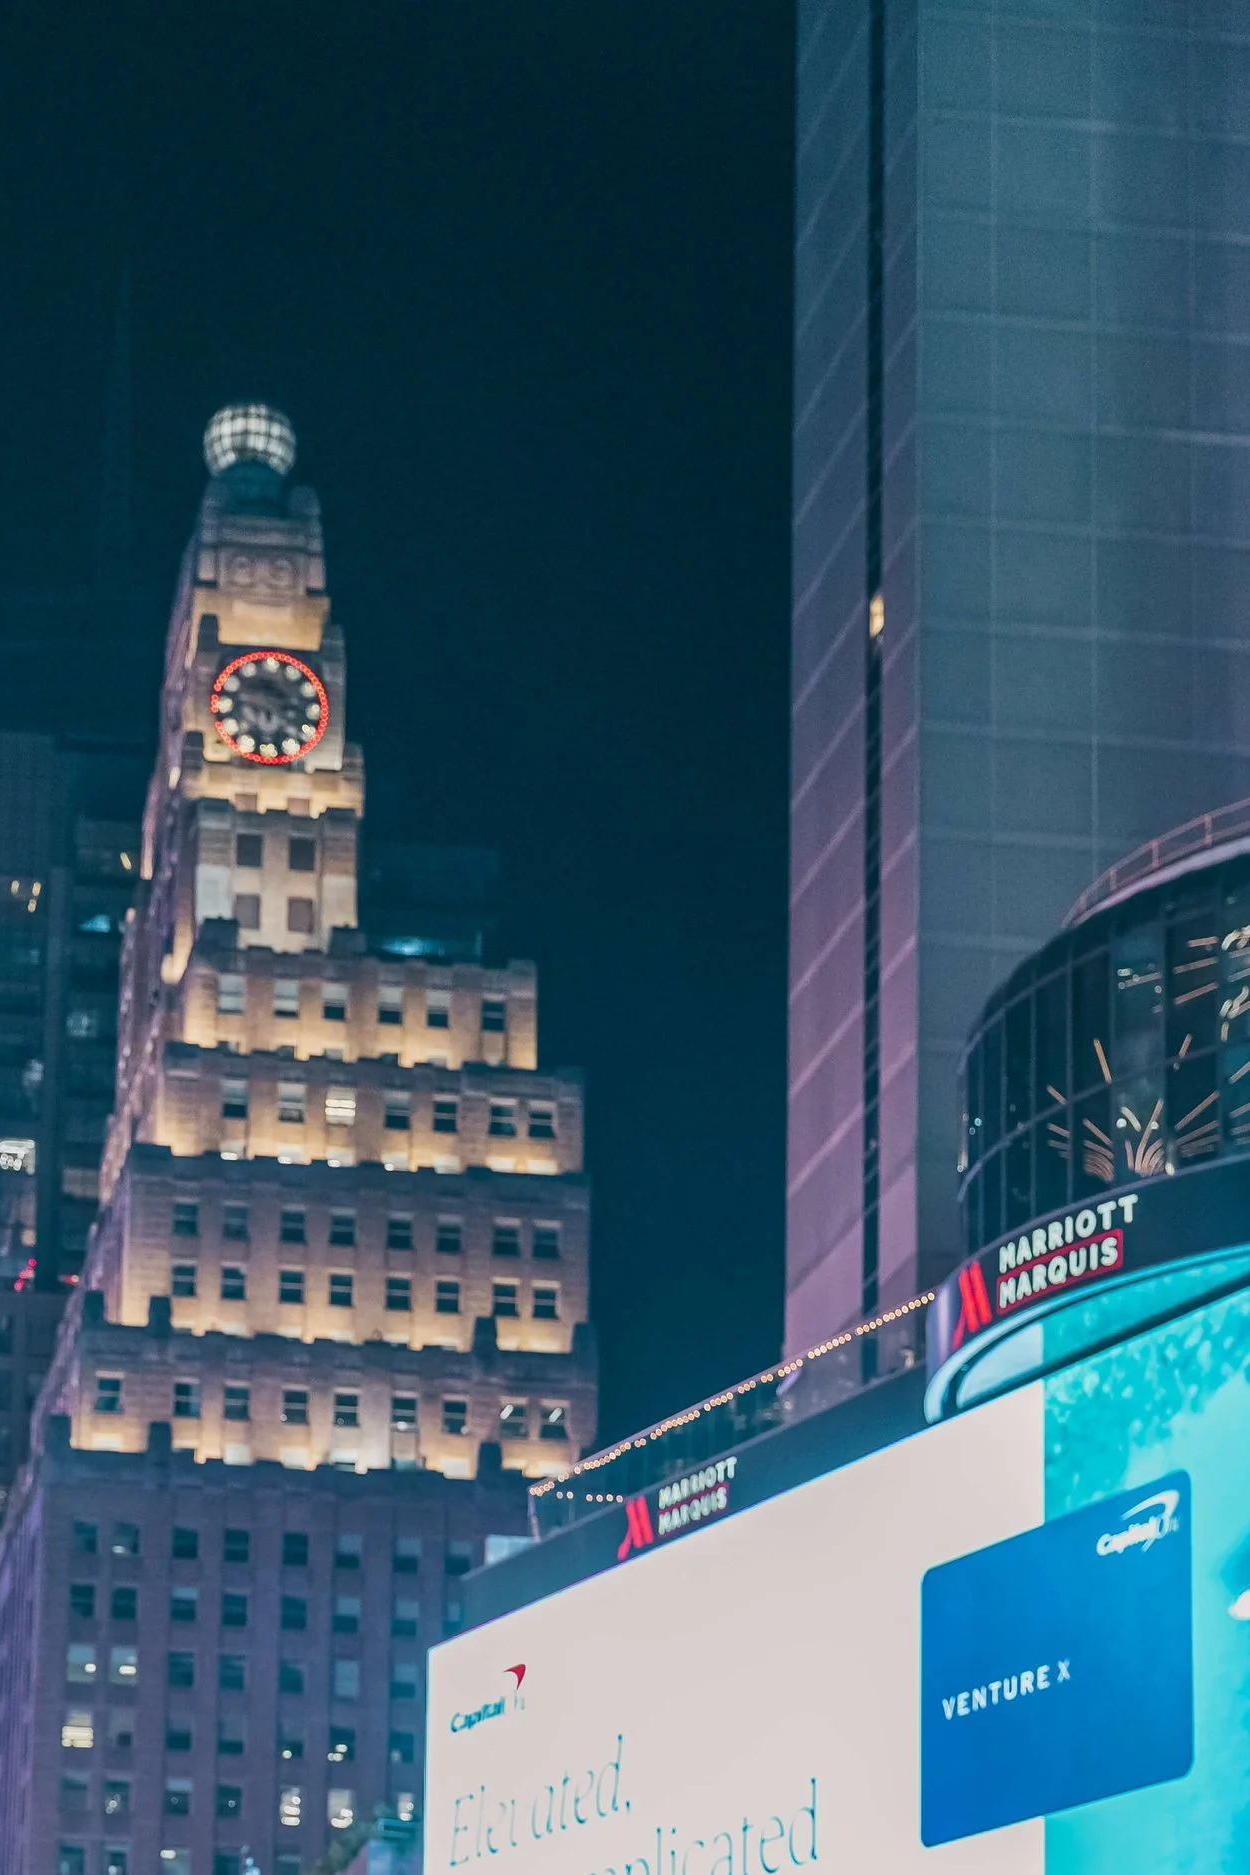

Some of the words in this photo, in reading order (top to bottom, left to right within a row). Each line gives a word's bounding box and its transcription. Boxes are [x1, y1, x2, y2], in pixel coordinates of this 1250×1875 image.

[999, 1194, 1138, 1274] MARRIOTT
[999, 1236, 1119, 1309] MARQUIS
[657, 1457, 738, 1509] MARRIOTT
[657, 1487, 728, 1535] MARQUIS
[942, 1664, 1051, 1720] VENTURE
[1057, 1658, 1071, 1683] X
